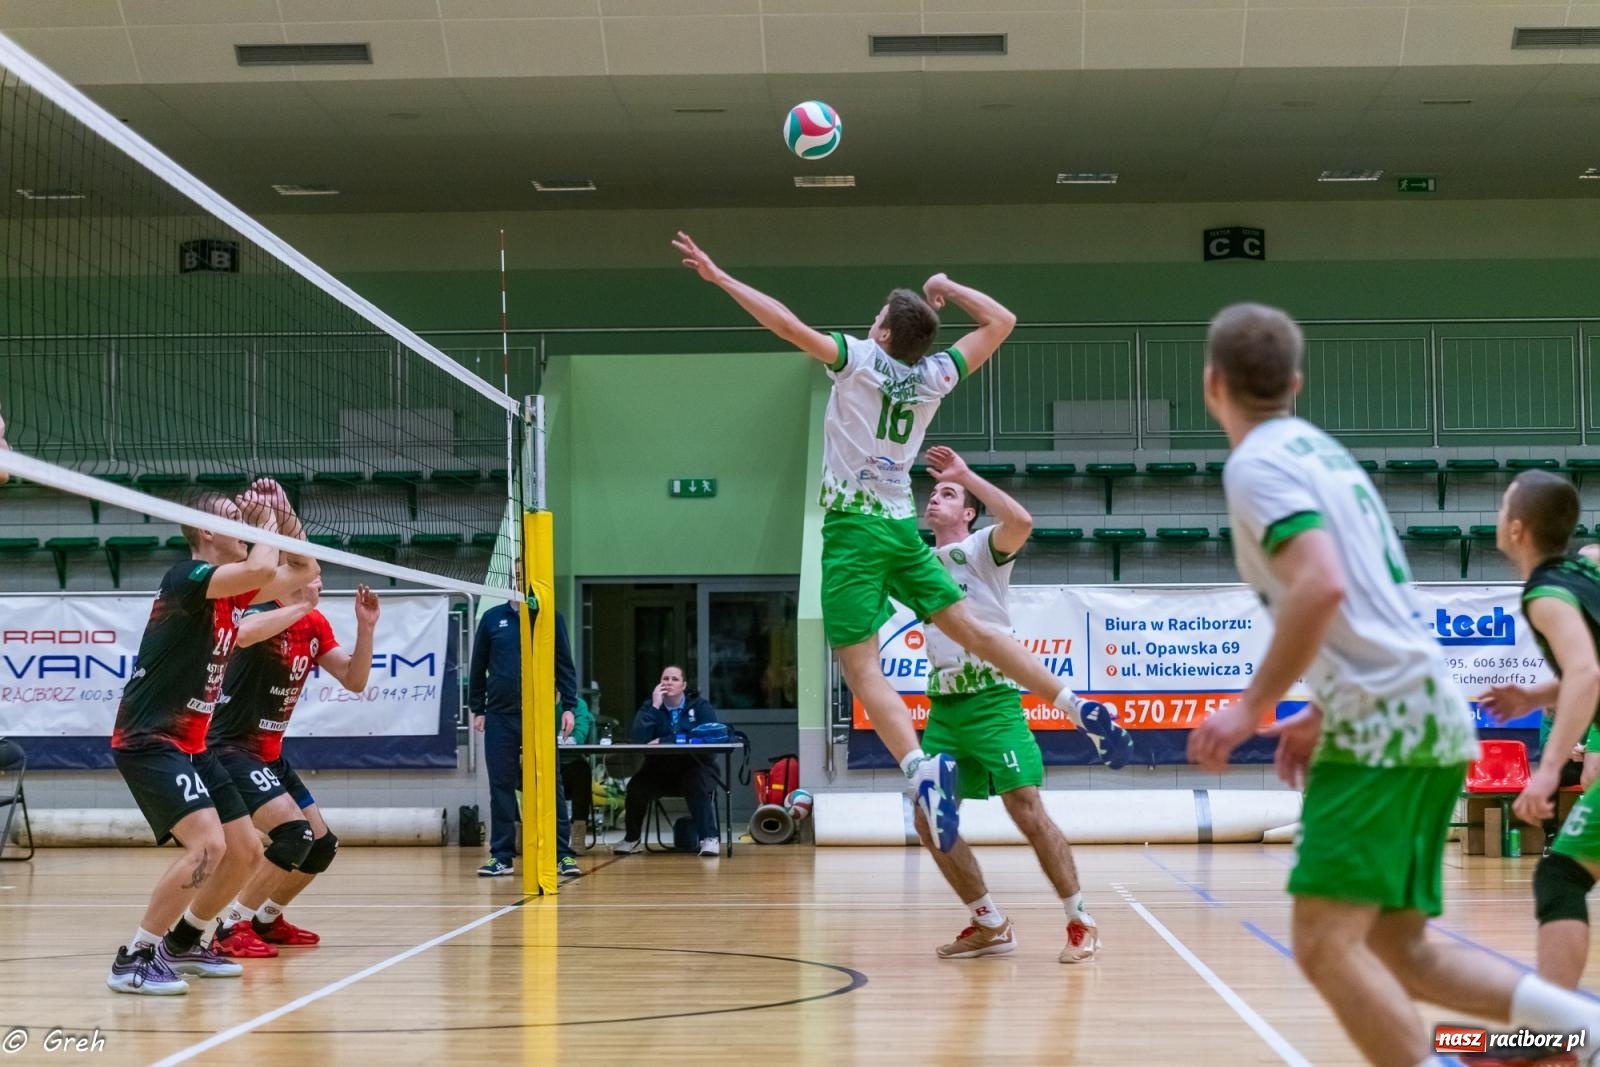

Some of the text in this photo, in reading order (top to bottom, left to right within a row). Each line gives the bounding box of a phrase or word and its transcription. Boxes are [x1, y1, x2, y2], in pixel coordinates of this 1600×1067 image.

[1209, 238, 1230, 256] C
[1243, 238, 1261, 256] C
[210, 250, 231, 268] B
[875, 393, 918, 445] 16
[1105, 617, 1252, 631] Biura w Raciborzu:
[3, 630, 116, 644] RADIO
[213, 627, 233, 656] 24
[1021, 639, 1072, 655] ULTI
[1121, 641, 1240, 657] ul. Opawska 69
[2, 655, 139, 679] VAN
[290, 655, 309, 681] 99
[1121, 663, 1141, 677] ul.
[1146, 662, 1240, 676] Mickiewicza
[1473, 658, 1496, 668] 606
[1498, 658, 1519, 668] 363
[1522, 657, 1544, 668] 647
[1530, 674, 1537, 684] 2
[411, 685, 436, 701] FM
[1123, 699, 1165, 723] 570
[1170, 699, 1198, 723] 77
[175, 772, 210, 802] 24
[249, 766, 281, 792] 99
